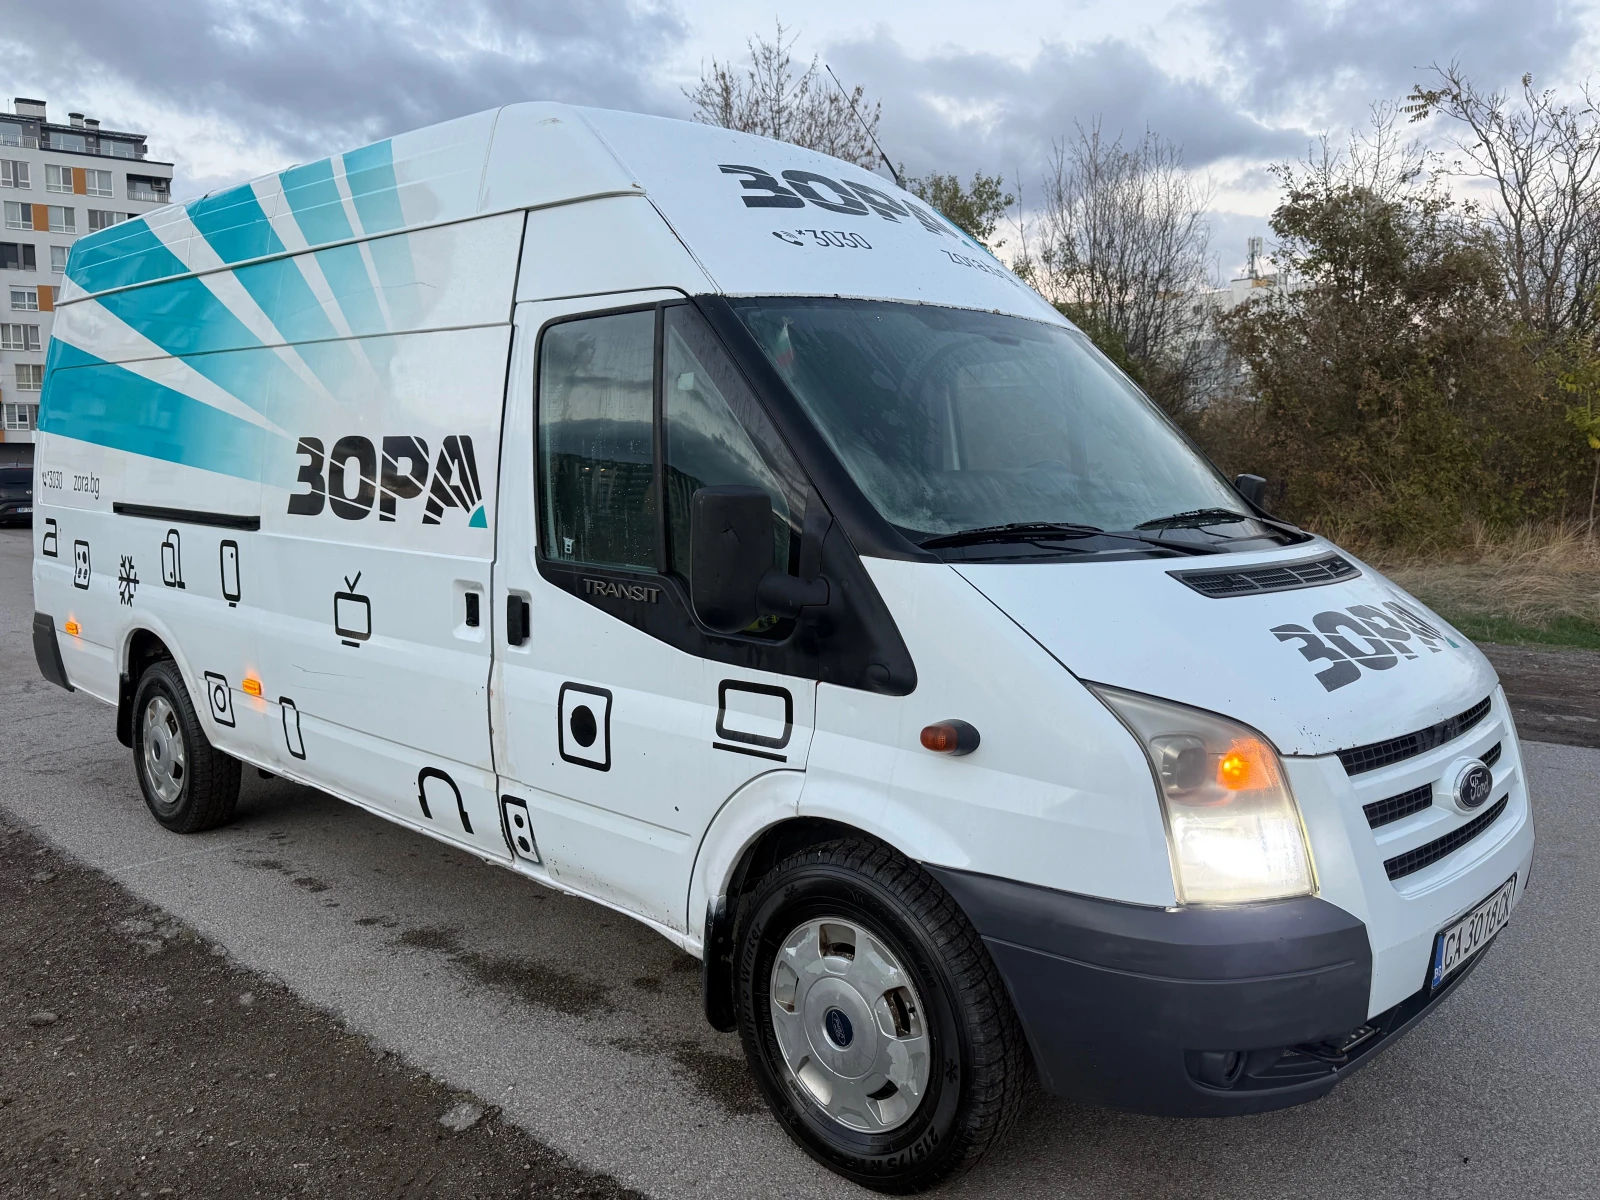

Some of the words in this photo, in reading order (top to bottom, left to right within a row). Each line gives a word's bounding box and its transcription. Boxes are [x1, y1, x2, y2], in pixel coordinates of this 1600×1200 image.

[717, 164, 960, 240] ЗОРА
[73, 471, 100, 500] zora.bg
[287, 435, 484, 526] ЗОРА
[583, 578, 662, 604] TRANSIT
[1269, 601, 1446, 692] ЗОРА
[1470, 771, 1489, 801] Ford
[740, 921, 763, 984] Winter
[1444, 926, 1463, 971] CA
[1463, 900, 1499, 954] 3018
